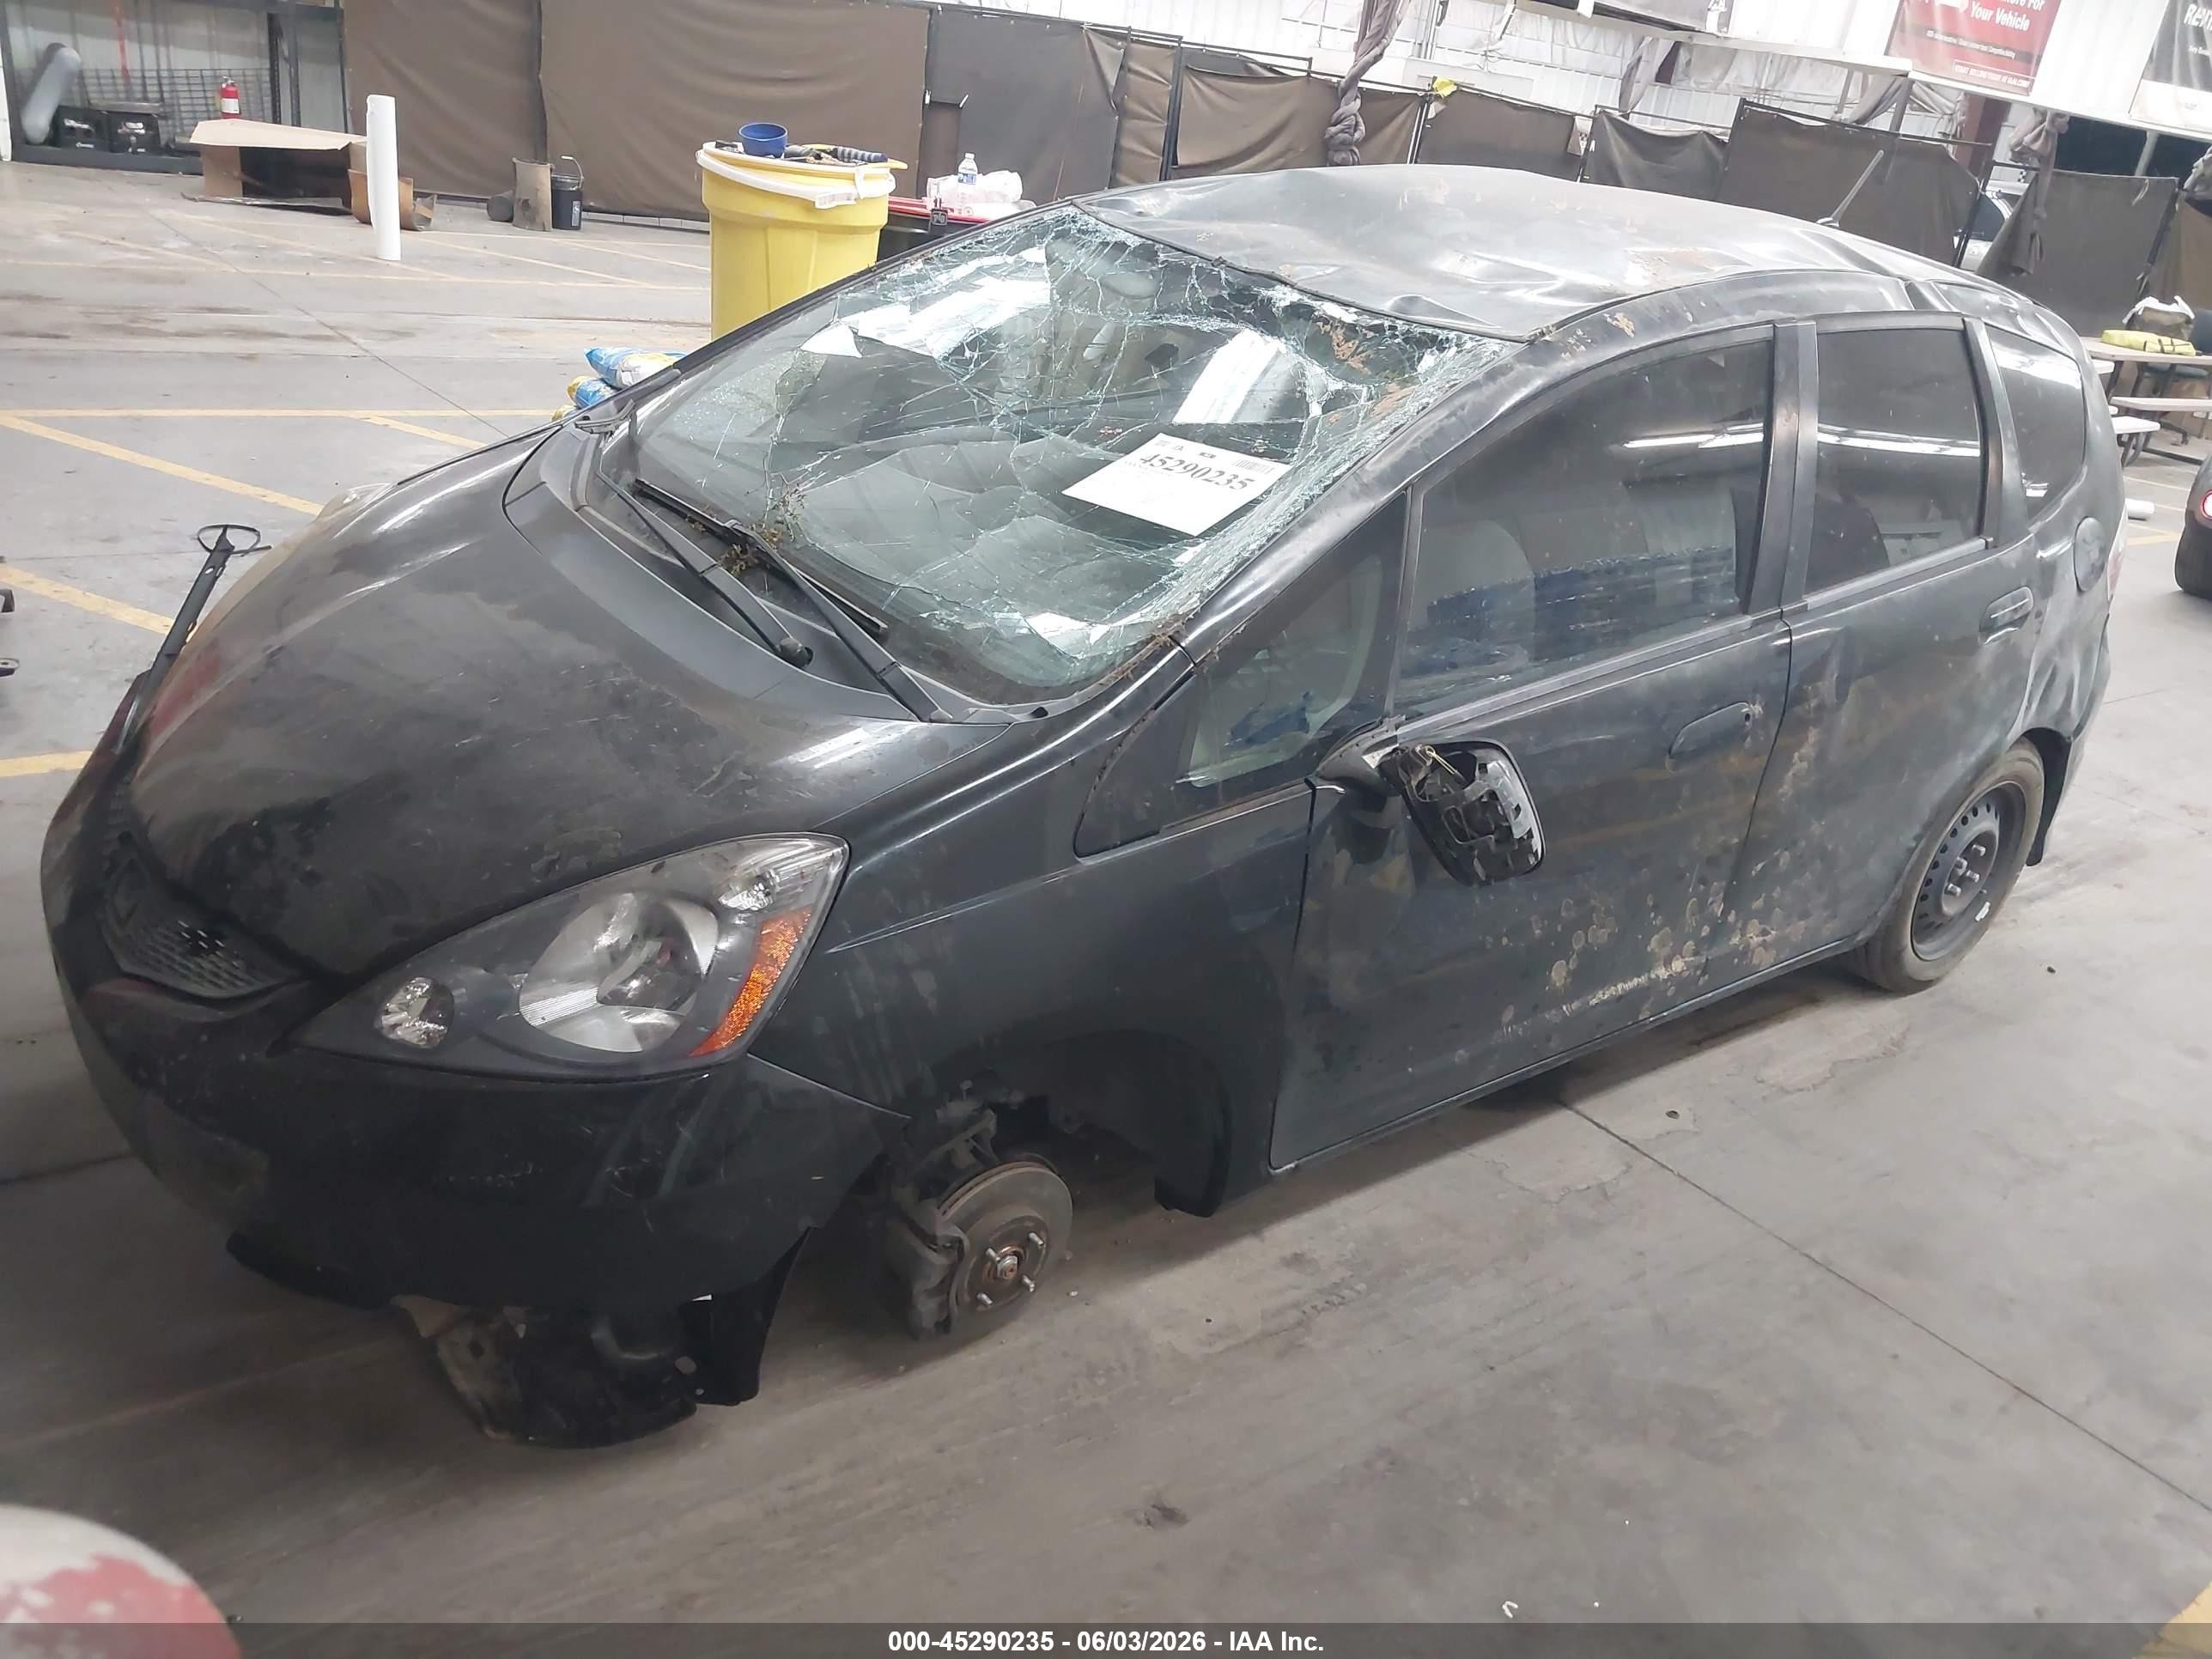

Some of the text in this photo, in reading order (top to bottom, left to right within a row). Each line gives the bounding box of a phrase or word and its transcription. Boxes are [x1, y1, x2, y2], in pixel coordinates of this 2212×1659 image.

[1971, 1, 2030, 32] Your Vehicle
[1139, 453, 1255, 490] 45290235
